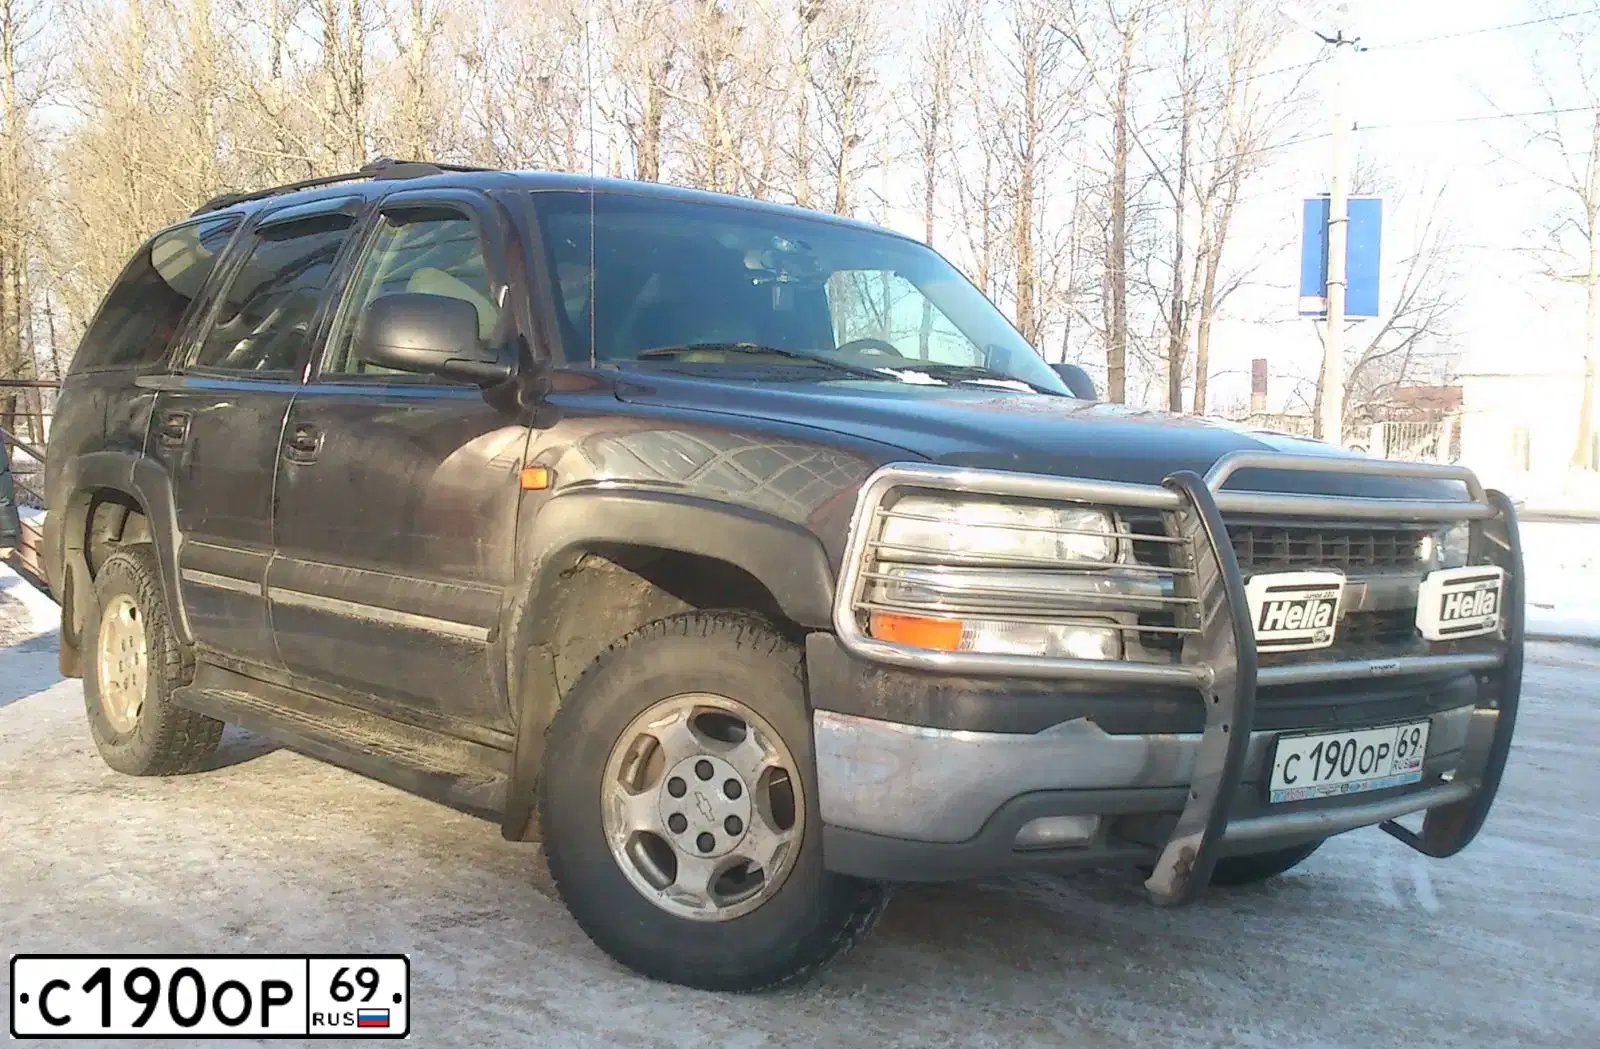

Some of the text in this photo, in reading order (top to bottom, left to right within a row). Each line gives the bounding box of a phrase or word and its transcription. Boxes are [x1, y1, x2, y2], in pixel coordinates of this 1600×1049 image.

[1262, 599, 1333, 631] Hella
[1443, 589, 1496, 620] Hella
[1397, 727, 1421, 758] 69
